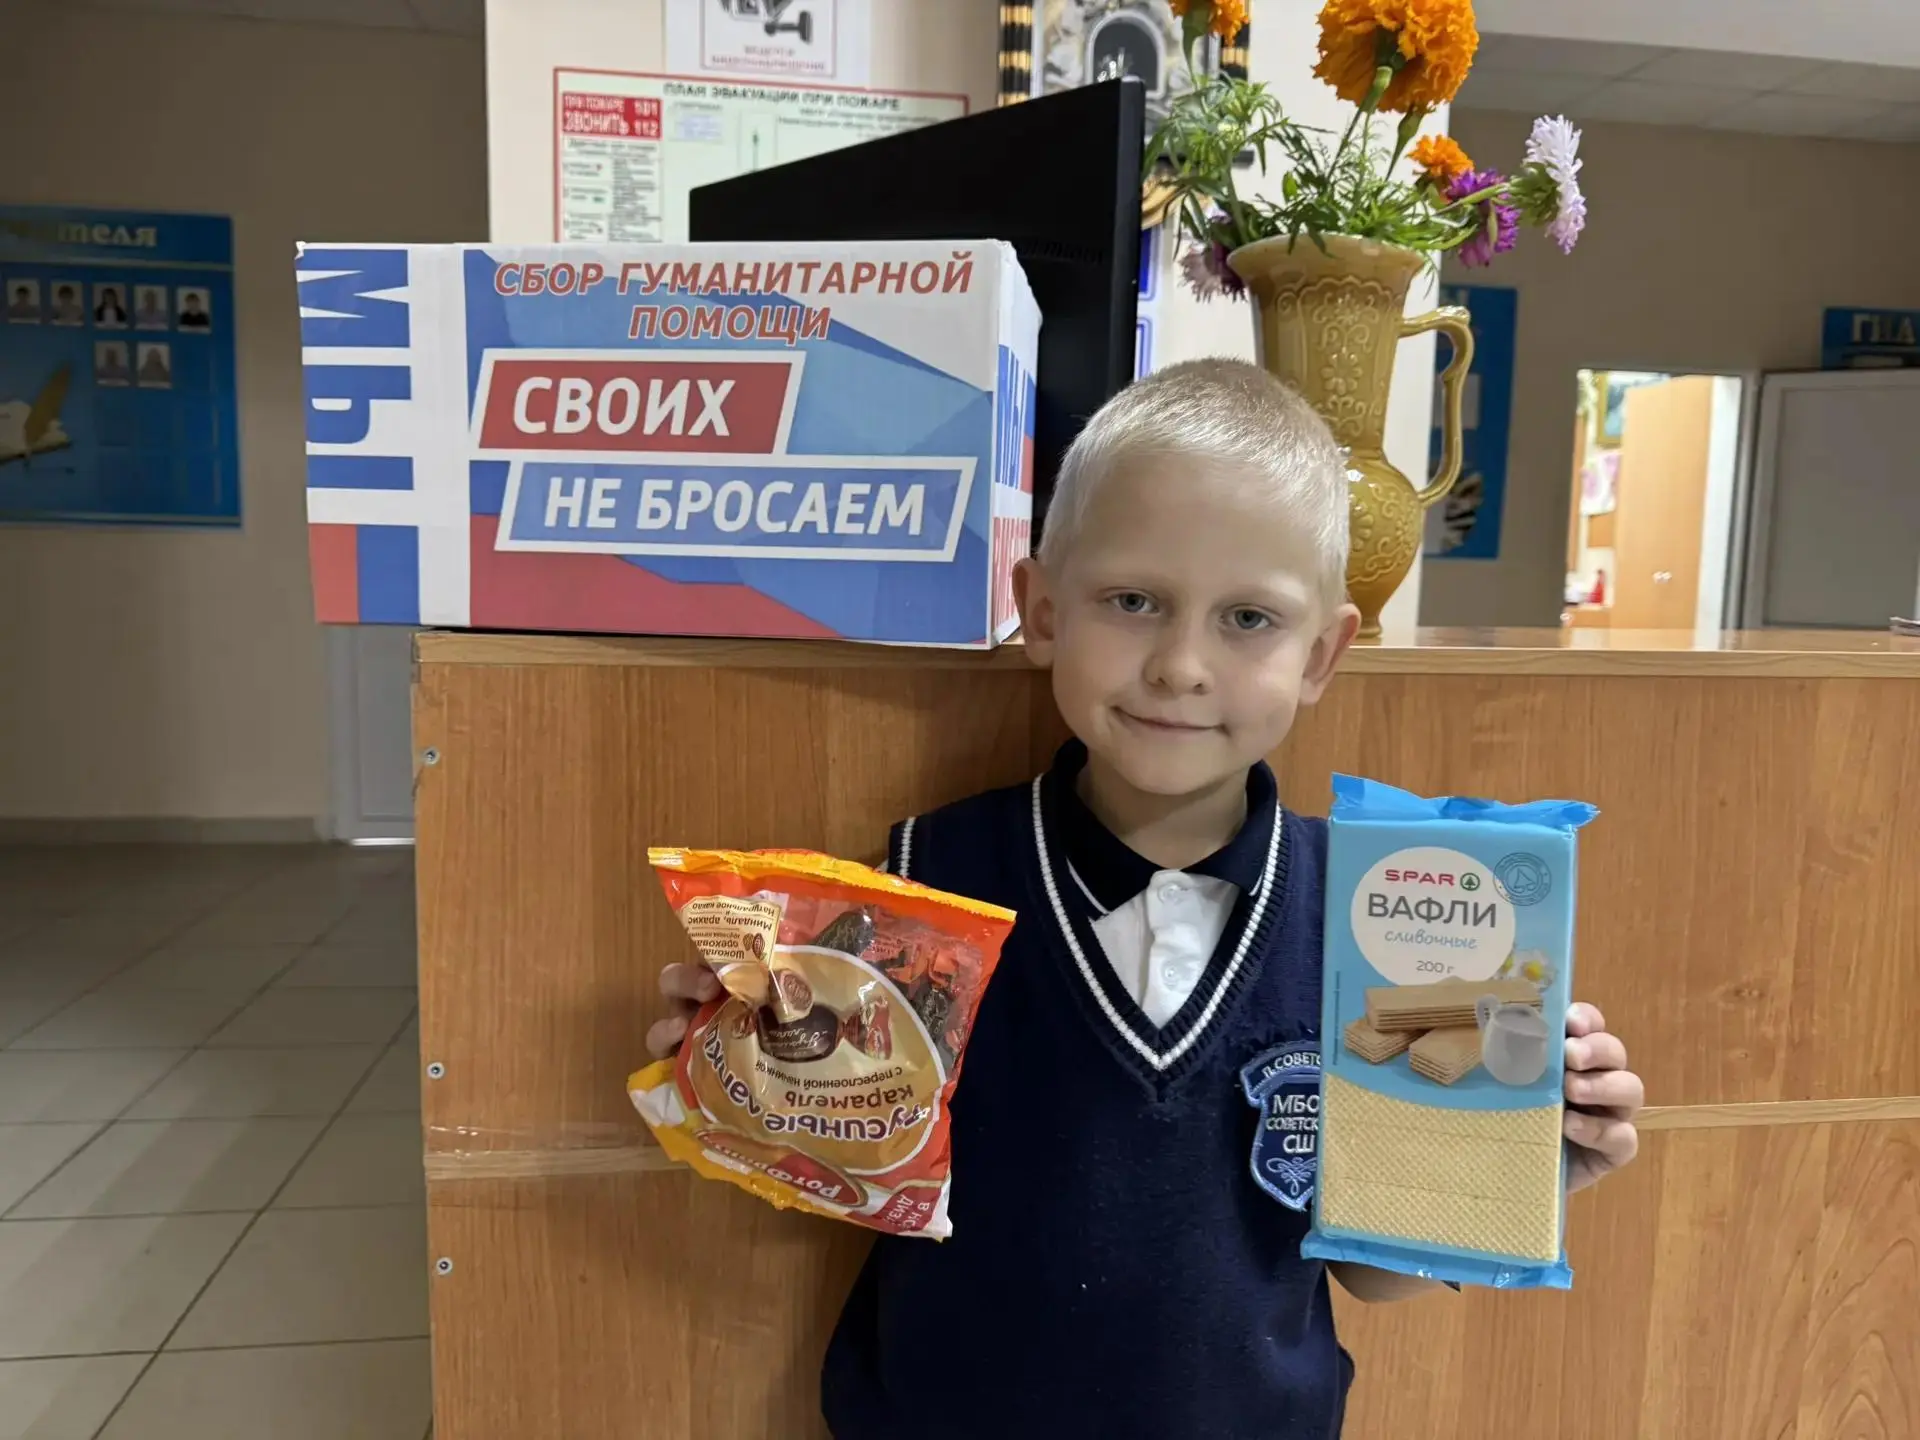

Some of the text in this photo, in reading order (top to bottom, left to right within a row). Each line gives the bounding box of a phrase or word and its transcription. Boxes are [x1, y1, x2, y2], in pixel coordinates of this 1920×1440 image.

[663, 82, 899, 109] ПЛАН ЭВАКУАЦИИ ПРИ ПОЖАРЕ
[564, 110, 630, 135] ЗВОНИТЬ
[633, 117, 659, 136] 112
[494, 250, 975, 297] СБОР ГУМАНИТАРНОЙ
[627, 304, 831, 347] ПОМОЩИ
[512, 376, 736, 437] СВОИХ
[544, 476, 926, 536] НЕ БРОСАЕМ
[1384, 869, 1455, 887] SPAR
[692, 901, 775, 917] Натуральное какао
[1367, 892, 1497, 929] ВАФЛИ
[688, 915, 773, 931] Миндаль, арахис
[1384, 929, 1478, 950] сливочные
[1416, 960, 1455, 974] 200 г
[702, 1022, 762, 1118] лапки
[753, 1059, 903, 1091] с переслоенной начинкой
[784, 1085, 914, 1112] карамель
[1282, 1134, 1316, 1153] СШ
[917, 1202, 930, 1211] В
